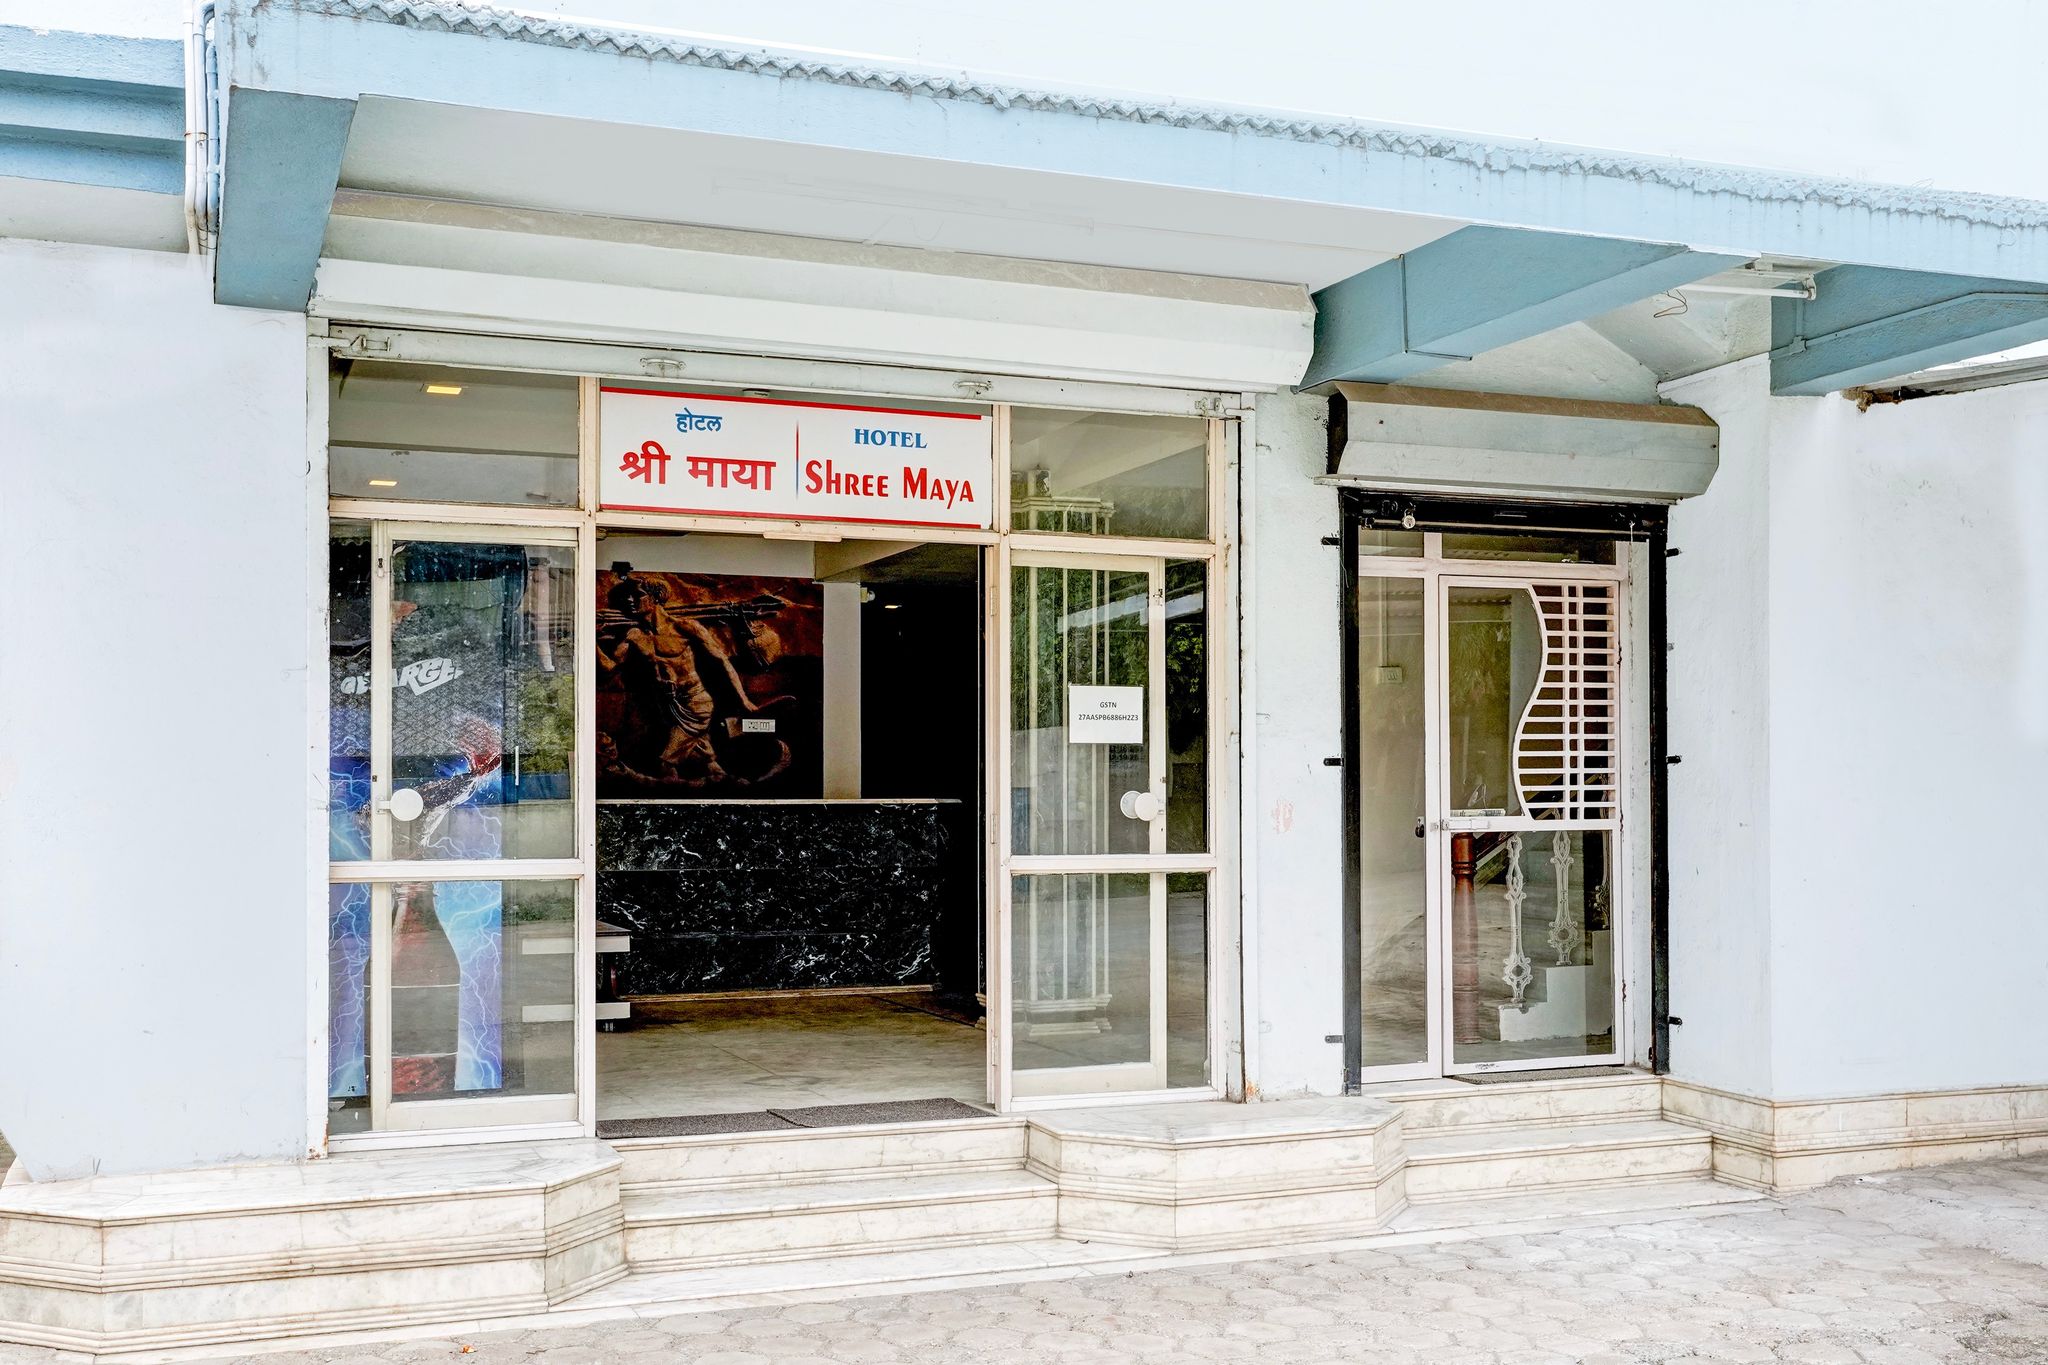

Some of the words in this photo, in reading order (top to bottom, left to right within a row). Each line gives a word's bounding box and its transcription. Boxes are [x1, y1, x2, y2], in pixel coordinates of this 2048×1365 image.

[675, 407, 722, 433] होटल
[854, 428, 927, 450] HOTEL
[619, 440, 672, 485] श्री
[687, 455, 776, 491] माया
[903, 466, 974, 509] MAYA
